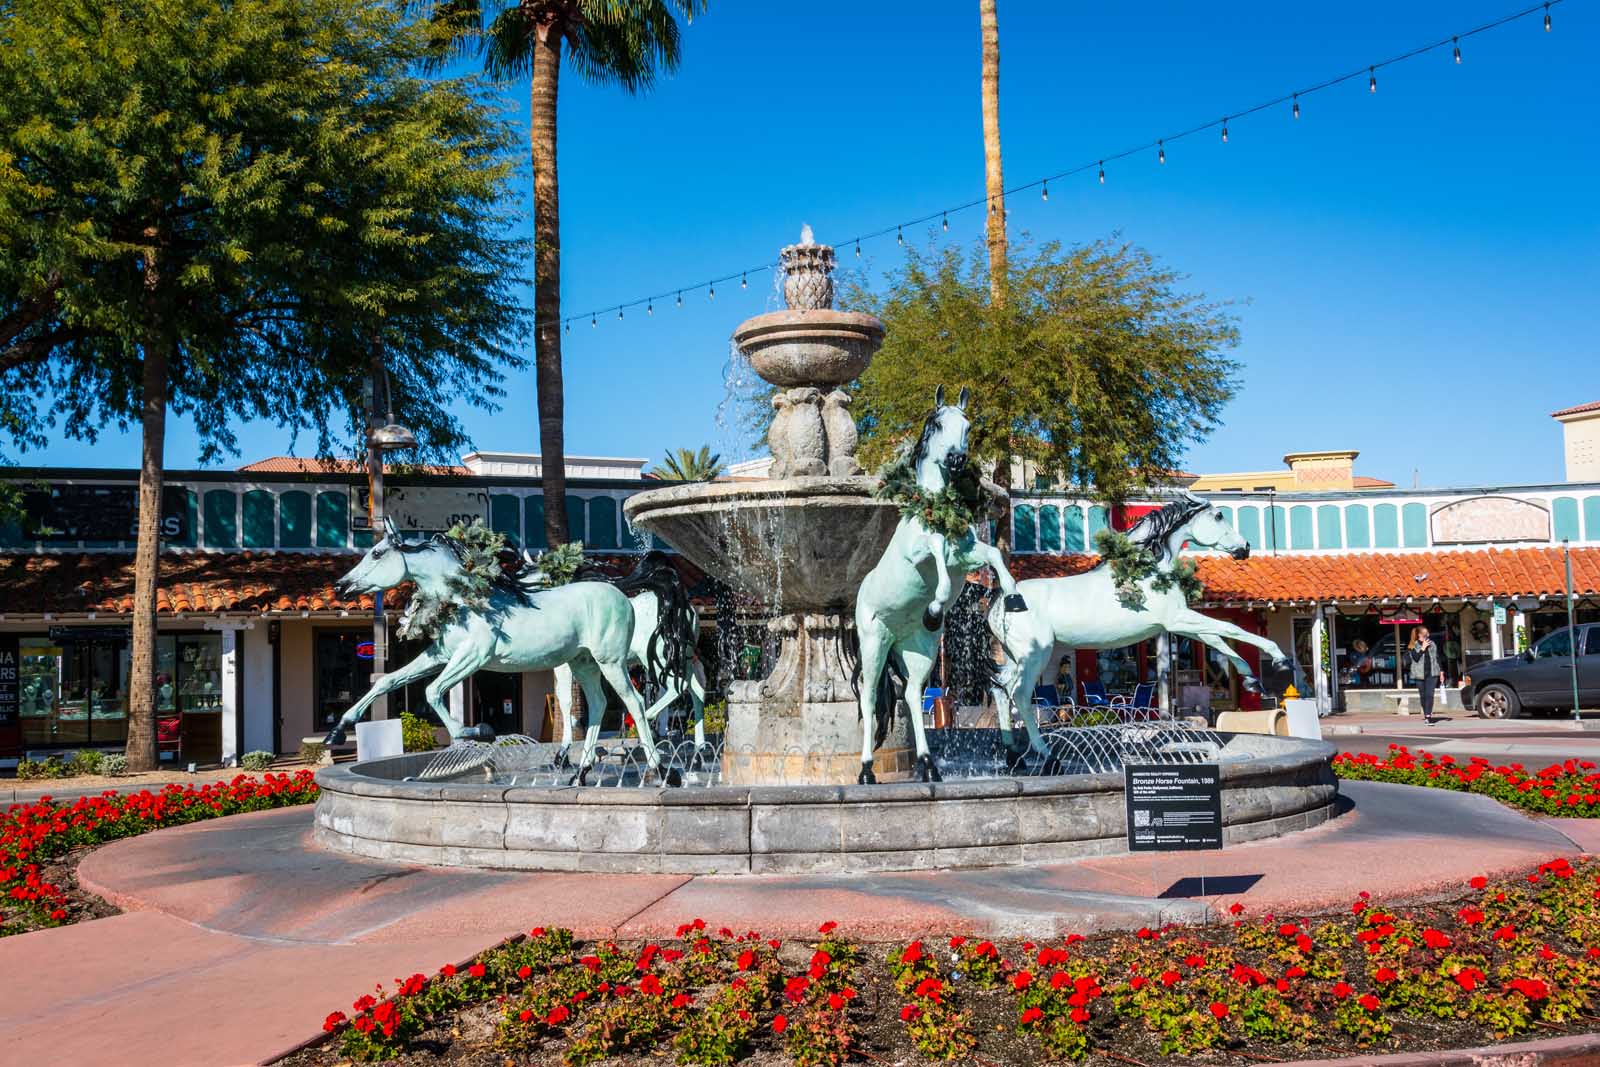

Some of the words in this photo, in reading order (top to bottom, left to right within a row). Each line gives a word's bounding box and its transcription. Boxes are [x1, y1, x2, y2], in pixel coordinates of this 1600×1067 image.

[1132, 777, 1154, 785] Bronze
[1155, 777, 1173, 785] Horse
[1173, 776, 1201, 785] Fountain,
